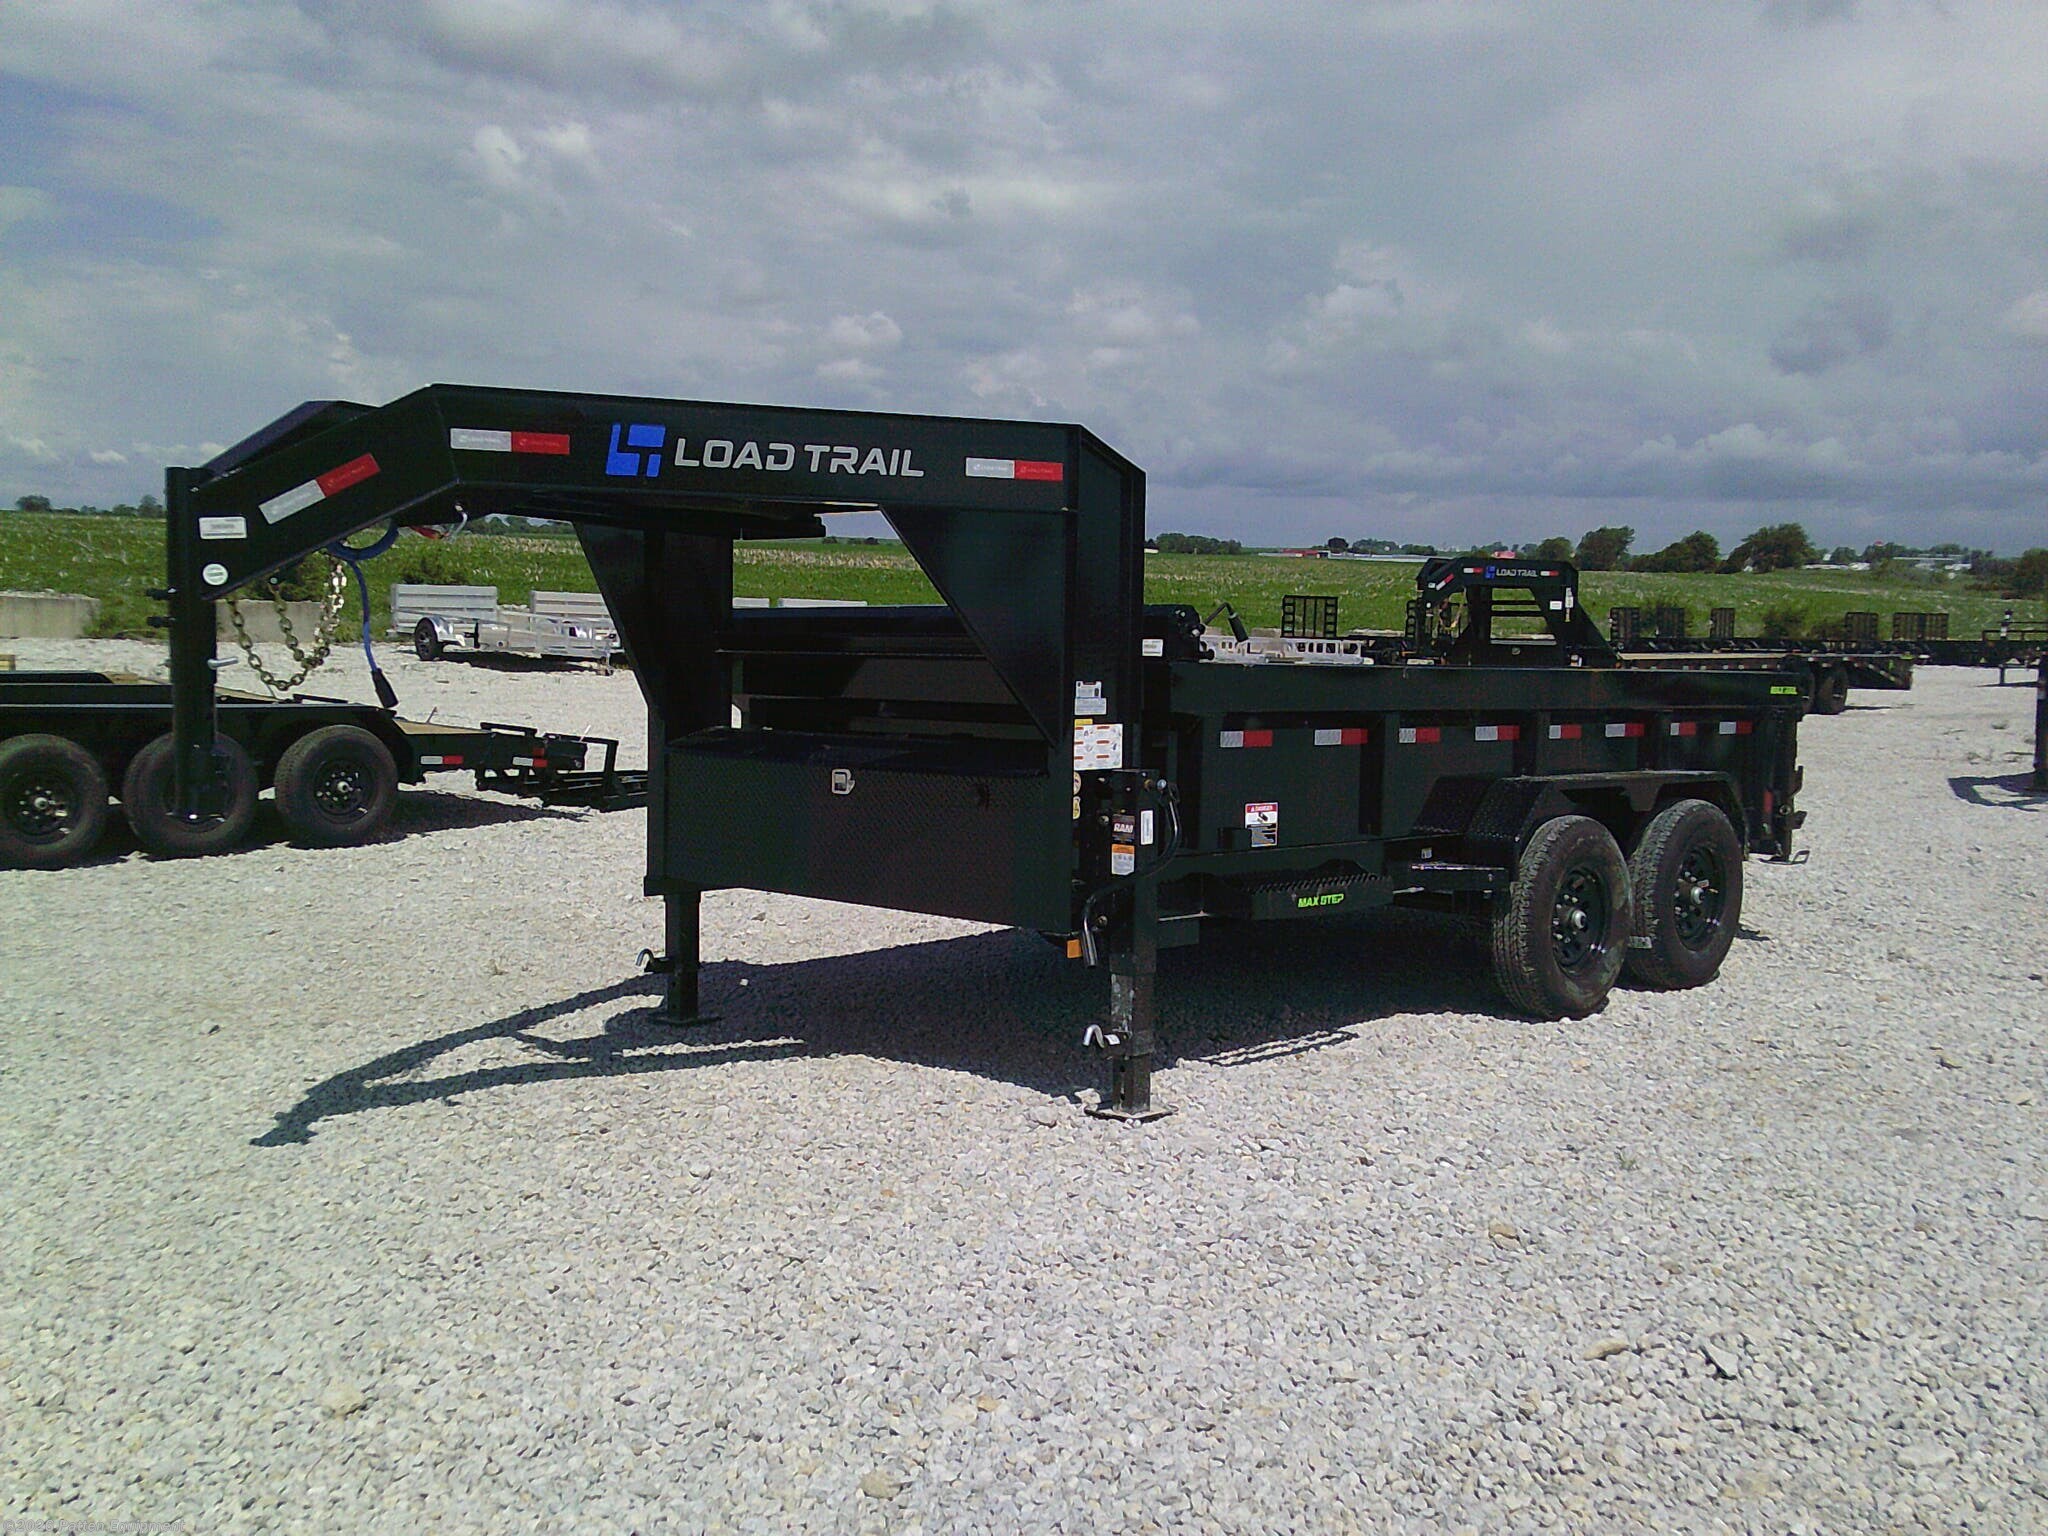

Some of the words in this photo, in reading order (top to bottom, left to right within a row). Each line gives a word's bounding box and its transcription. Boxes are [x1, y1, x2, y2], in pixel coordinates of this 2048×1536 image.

[674, 438, 795, 471] LOAD
[804, 444, 924, 477] TRAIL
[1113, 823, 1134, 833] RAM
[1298, 895, 1319, 908] MAX
